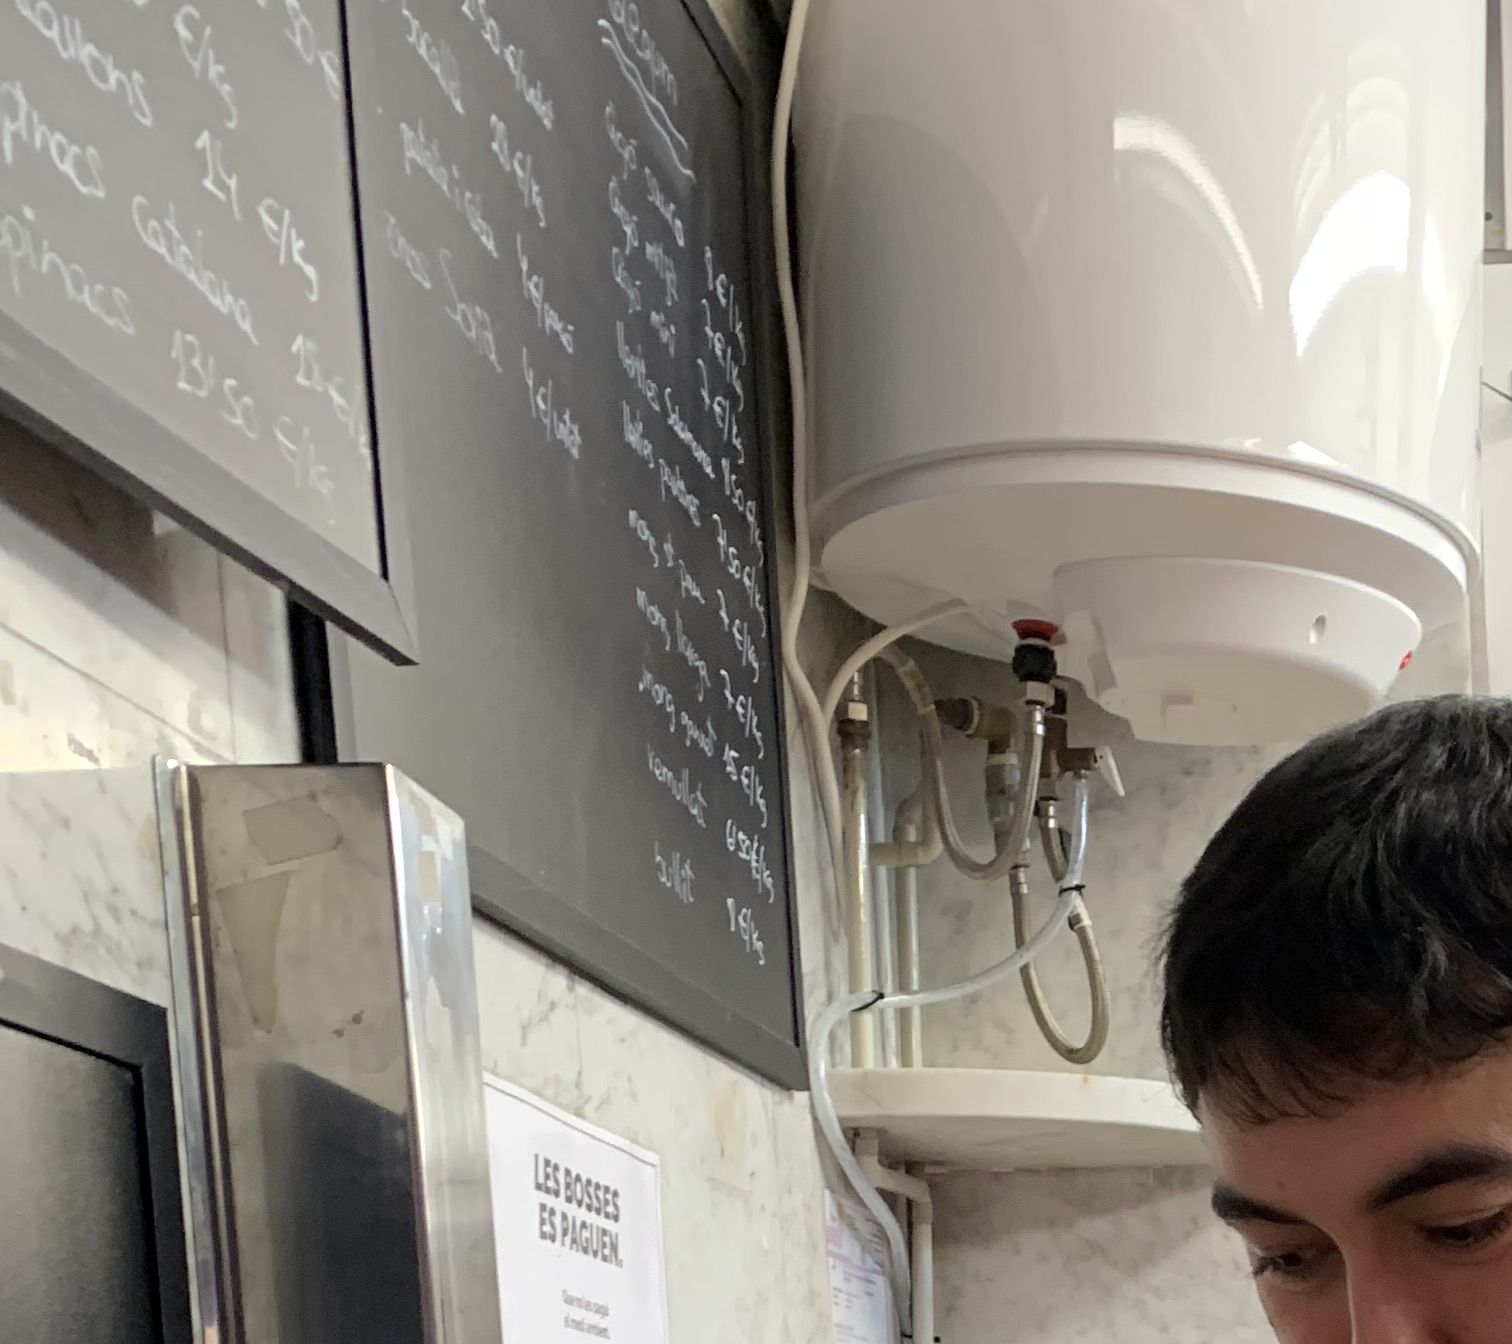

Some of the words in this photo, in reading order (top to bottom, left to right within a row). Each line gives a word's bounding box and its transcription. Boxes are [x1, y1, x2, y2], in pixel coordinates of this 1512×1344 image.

[196, 130, 241, 221] 14
[533, 1152, 561, 1200] LES
[565, 1165, 621, 1224] BOSSES
[538, 1202, 557, 1244] ES
[561, 1213, 623, 1269] PAGUEN.
